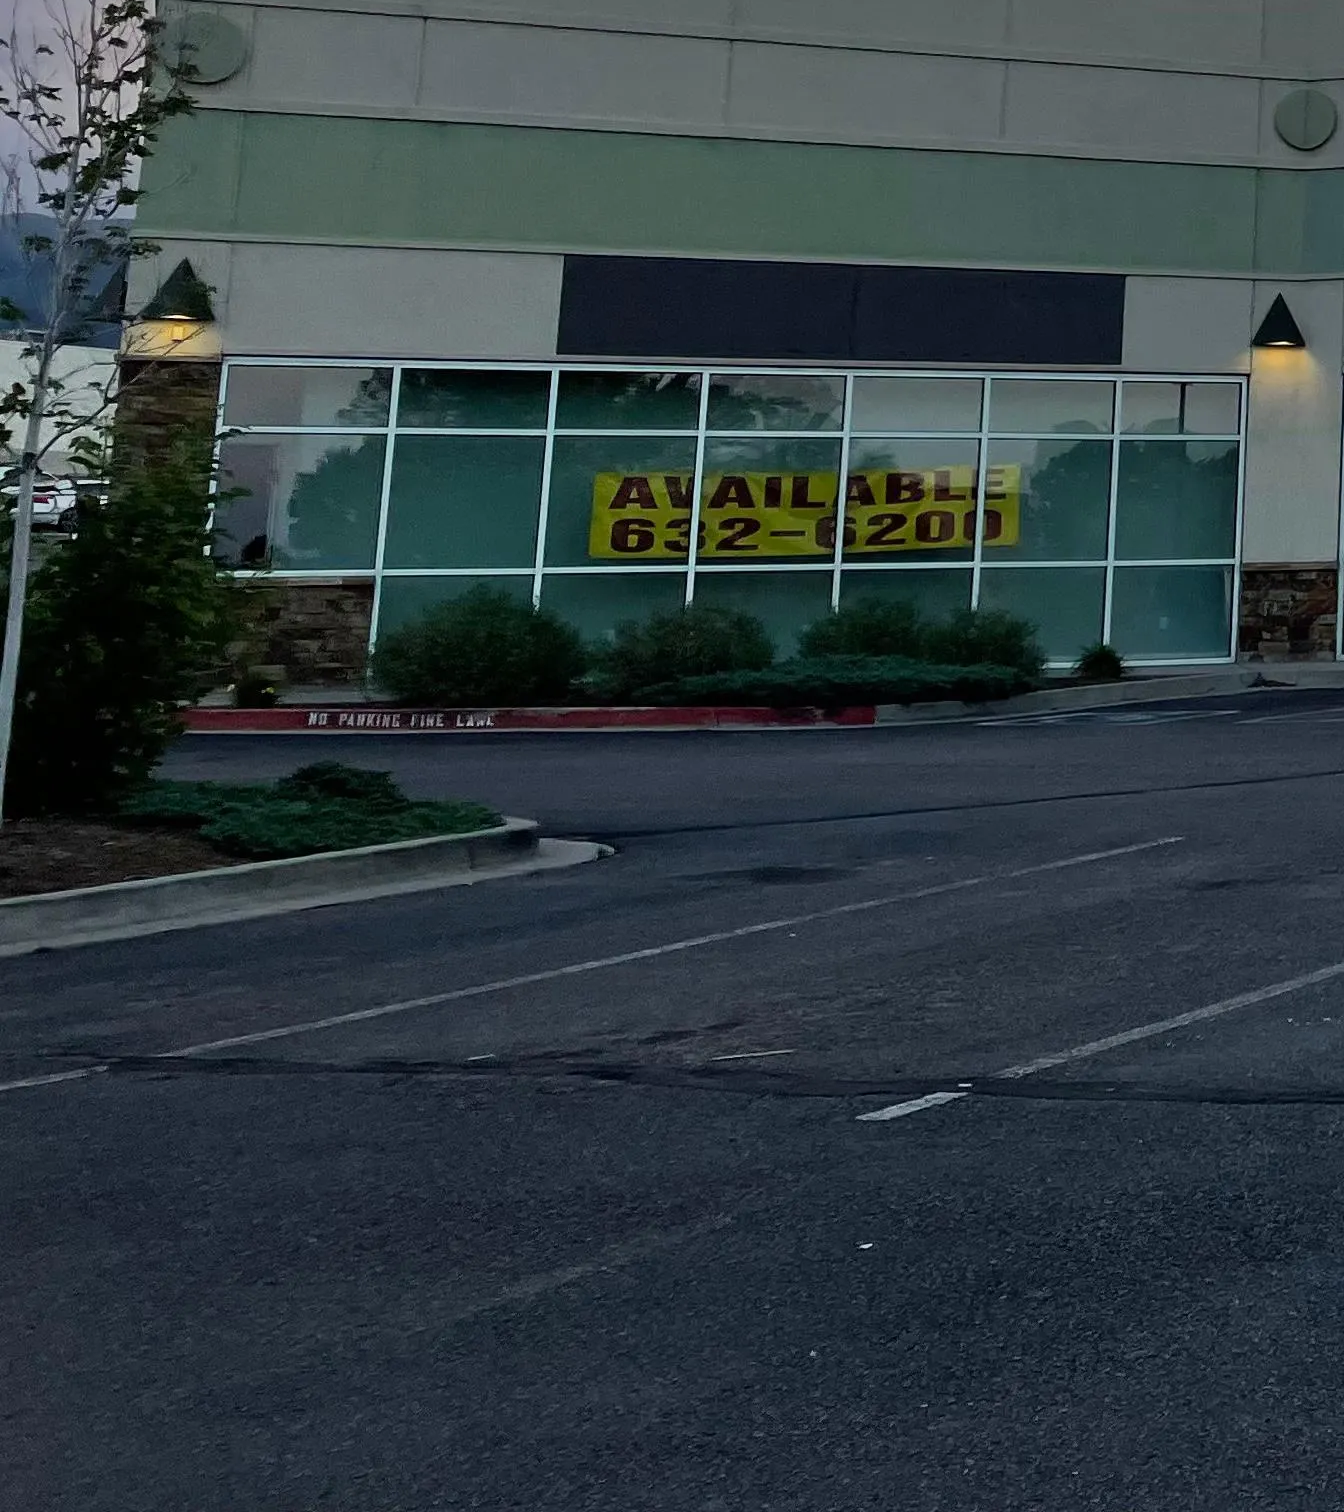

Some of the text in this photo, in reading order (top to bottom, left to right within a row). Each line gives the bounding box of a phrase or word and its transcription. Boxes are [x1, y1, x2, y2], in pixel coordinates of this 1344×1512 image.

[608, 468, 1007, 510] AVAILABLE
[610, 509, 1003, 553] 632-6200
[308, 712, 328, 726] NO
[339, 713, 401, 728] PARKING
